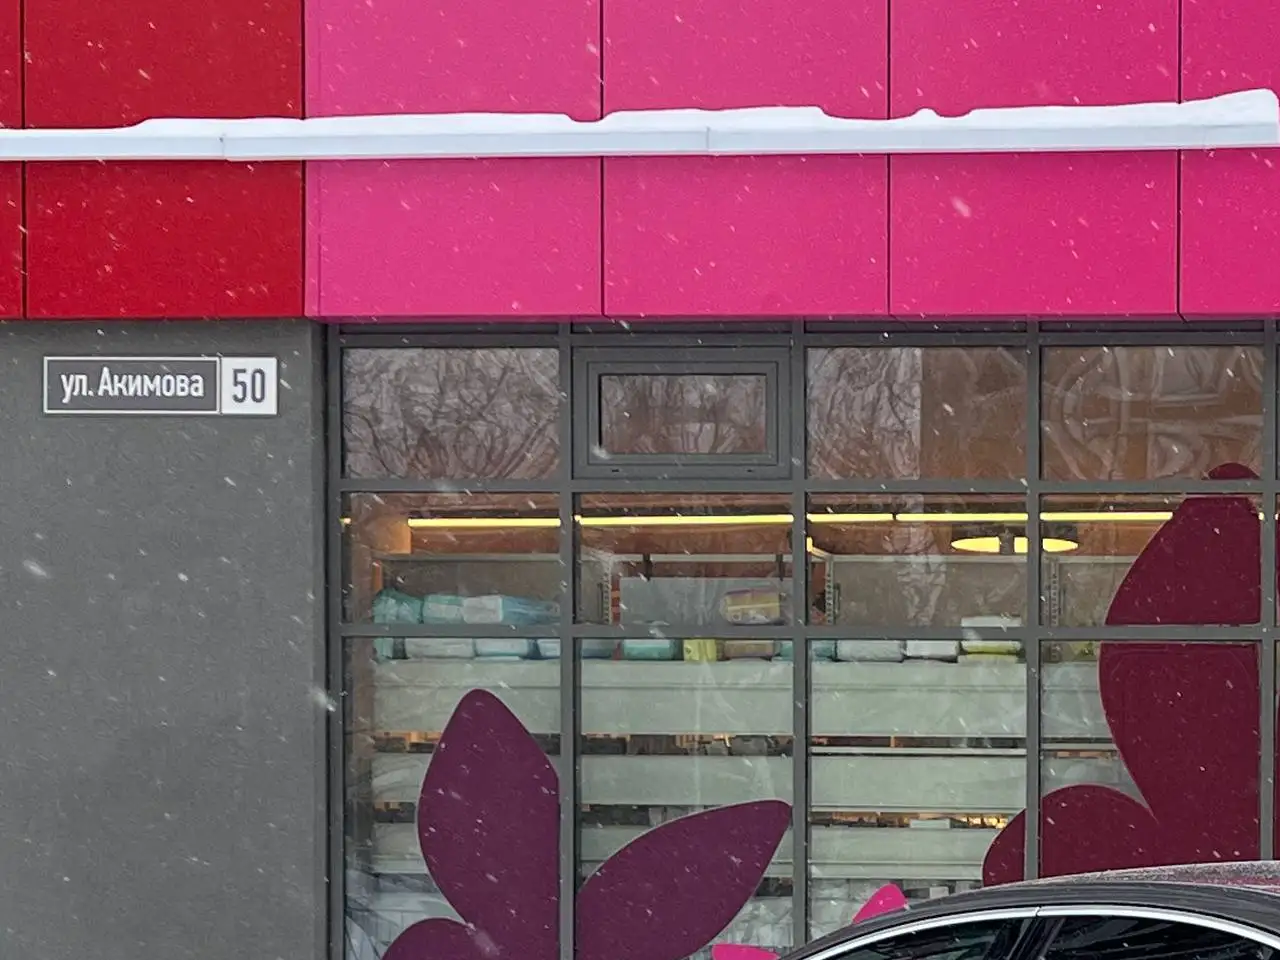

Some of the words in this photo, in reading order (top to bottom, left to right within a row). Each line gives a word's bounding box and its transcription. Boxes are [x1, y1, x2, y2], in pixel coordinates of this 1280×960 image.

[60, 373, 94, 404] ул.
[98, 366, 204, 397] Акимова
[232, 368, 266, 403] 50
